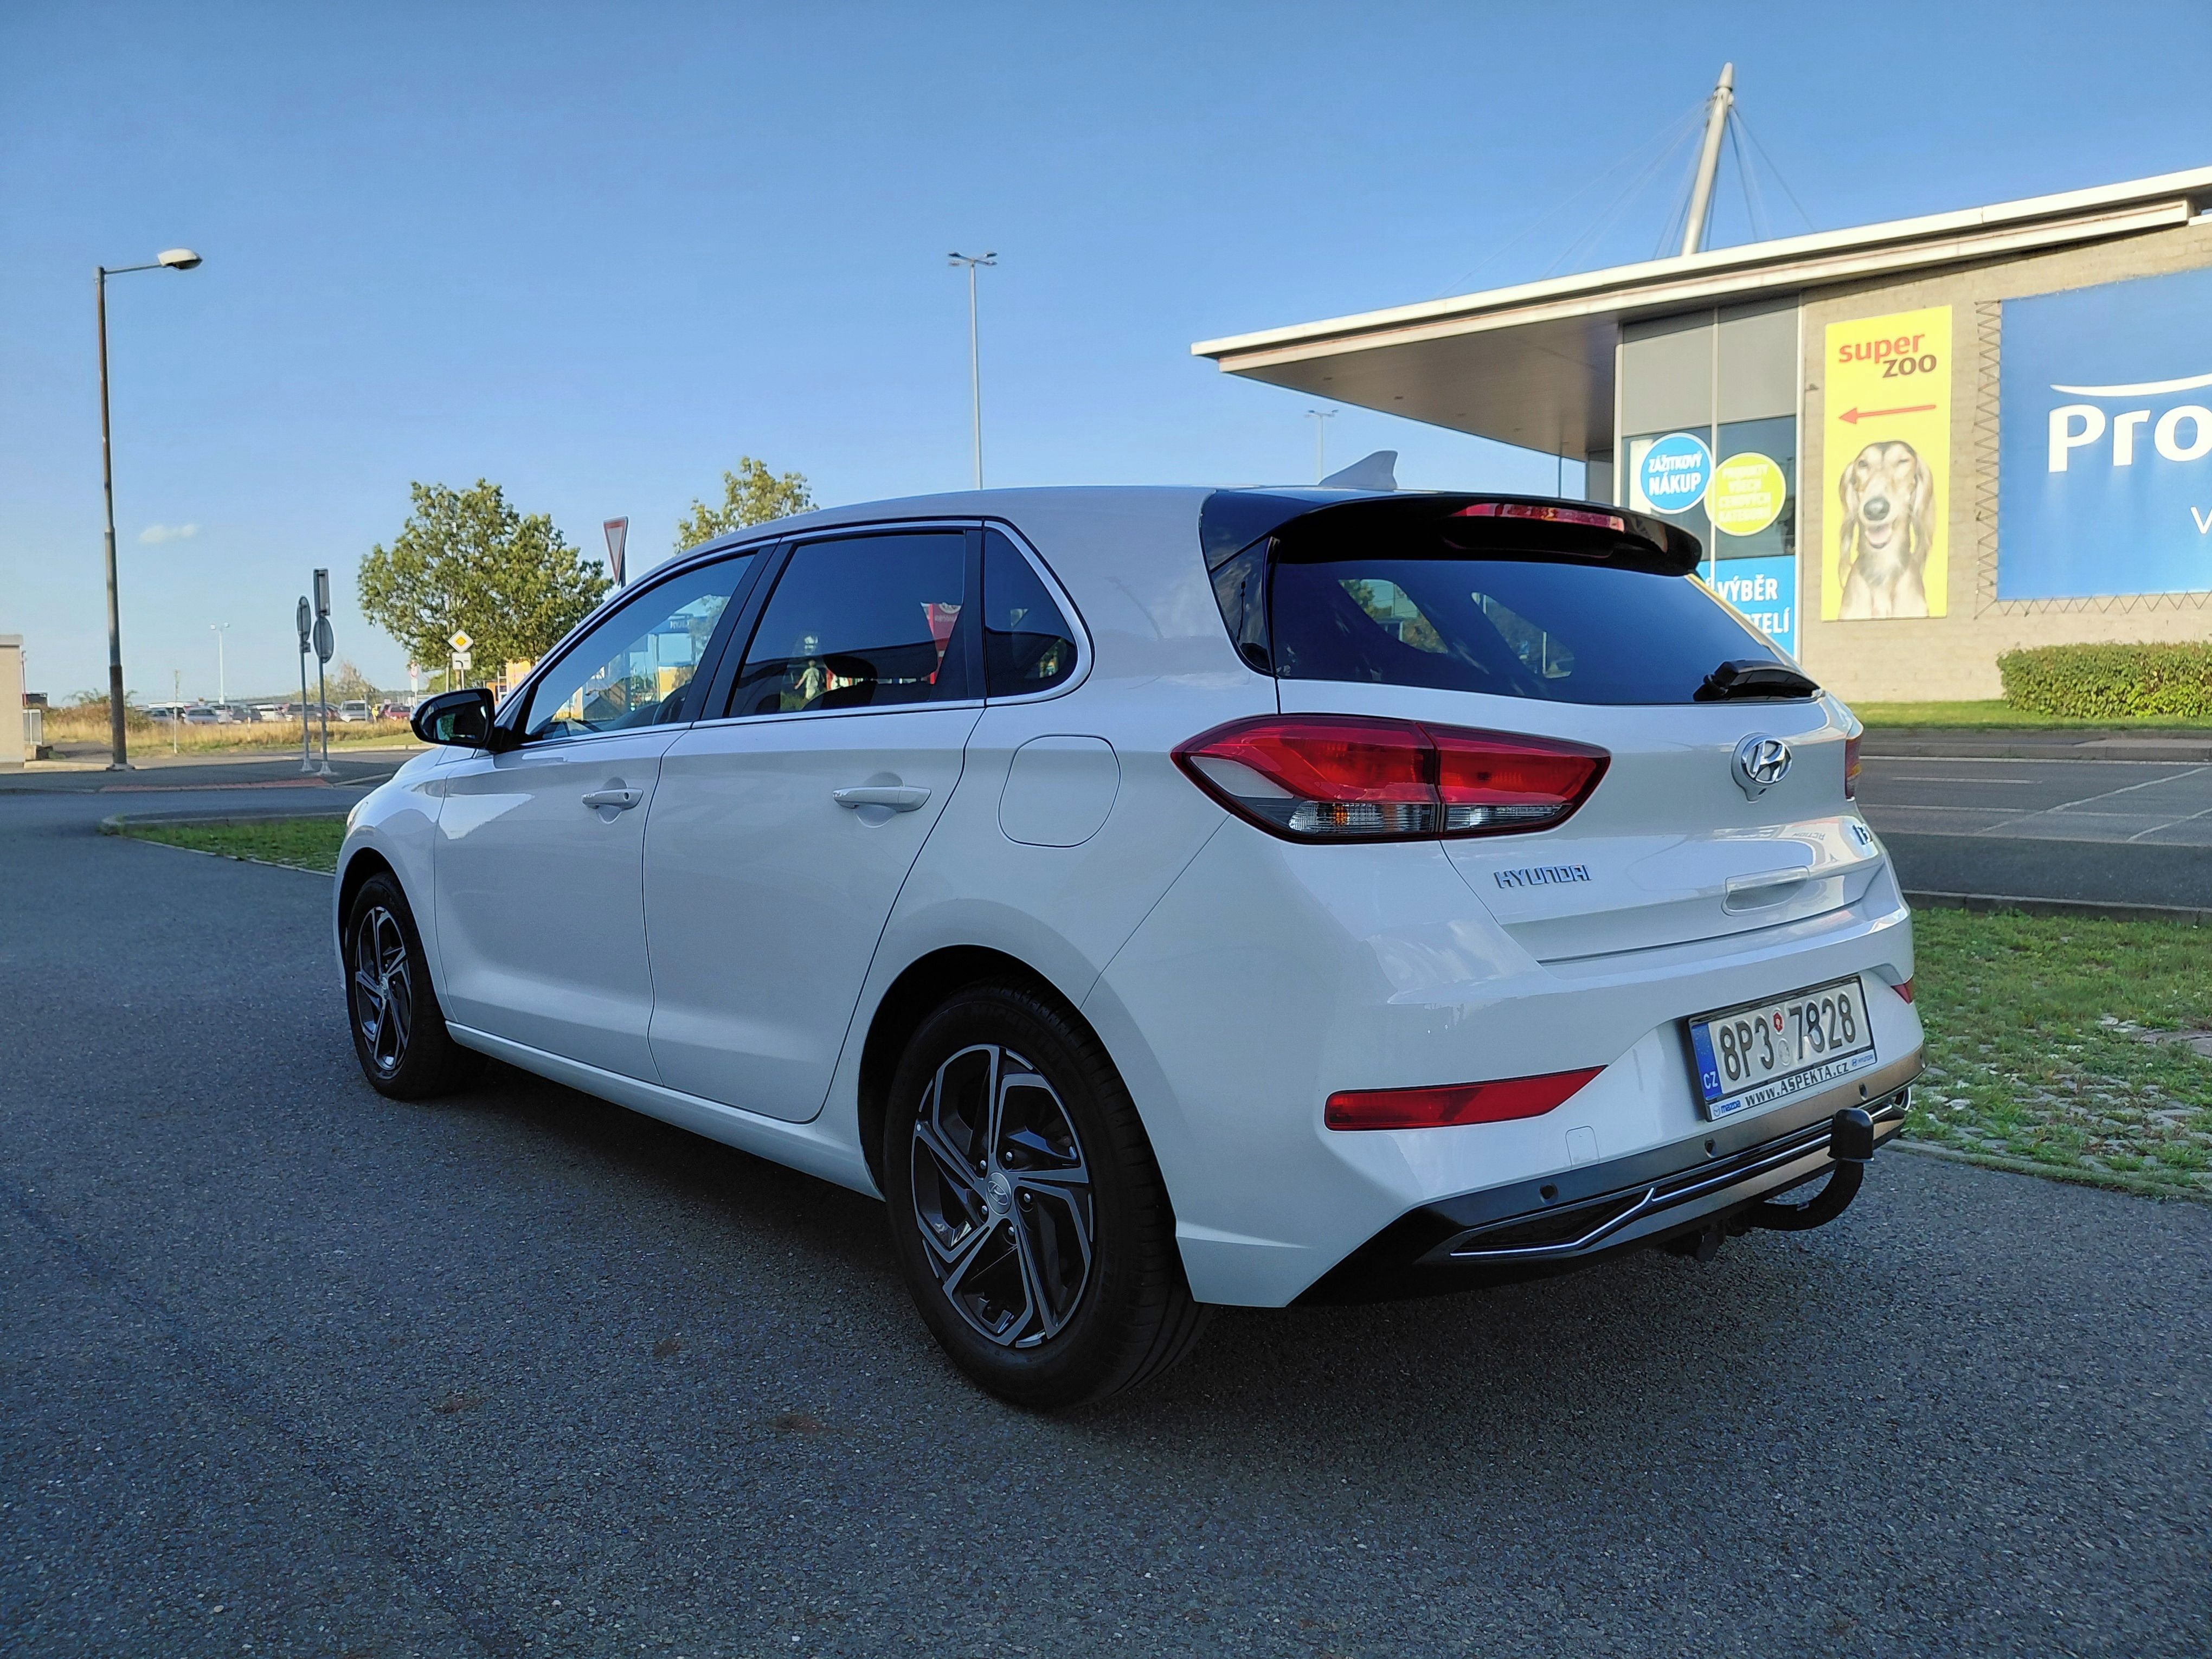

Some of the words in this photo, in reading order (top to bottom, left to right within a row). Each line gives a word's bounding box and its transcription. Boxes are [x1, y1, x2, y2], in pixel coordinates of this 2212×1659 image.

[1838, 333, 1925, 364] super
[1882, 355, 1937, 378] zoo
[2048, 403, 2212, 473] Pro
[1648, 471, 1702, 496] NÁKUP
[1717, 574, 1778, 602] VÝBĚR
[1493, 863, 1592, 889] HYUNDAI
[1719, 1016, 1775, 1082] 8P3
[1788, 992, 1856, 1060] 7828
[1703, 1071, 1719, 1089] CZ
